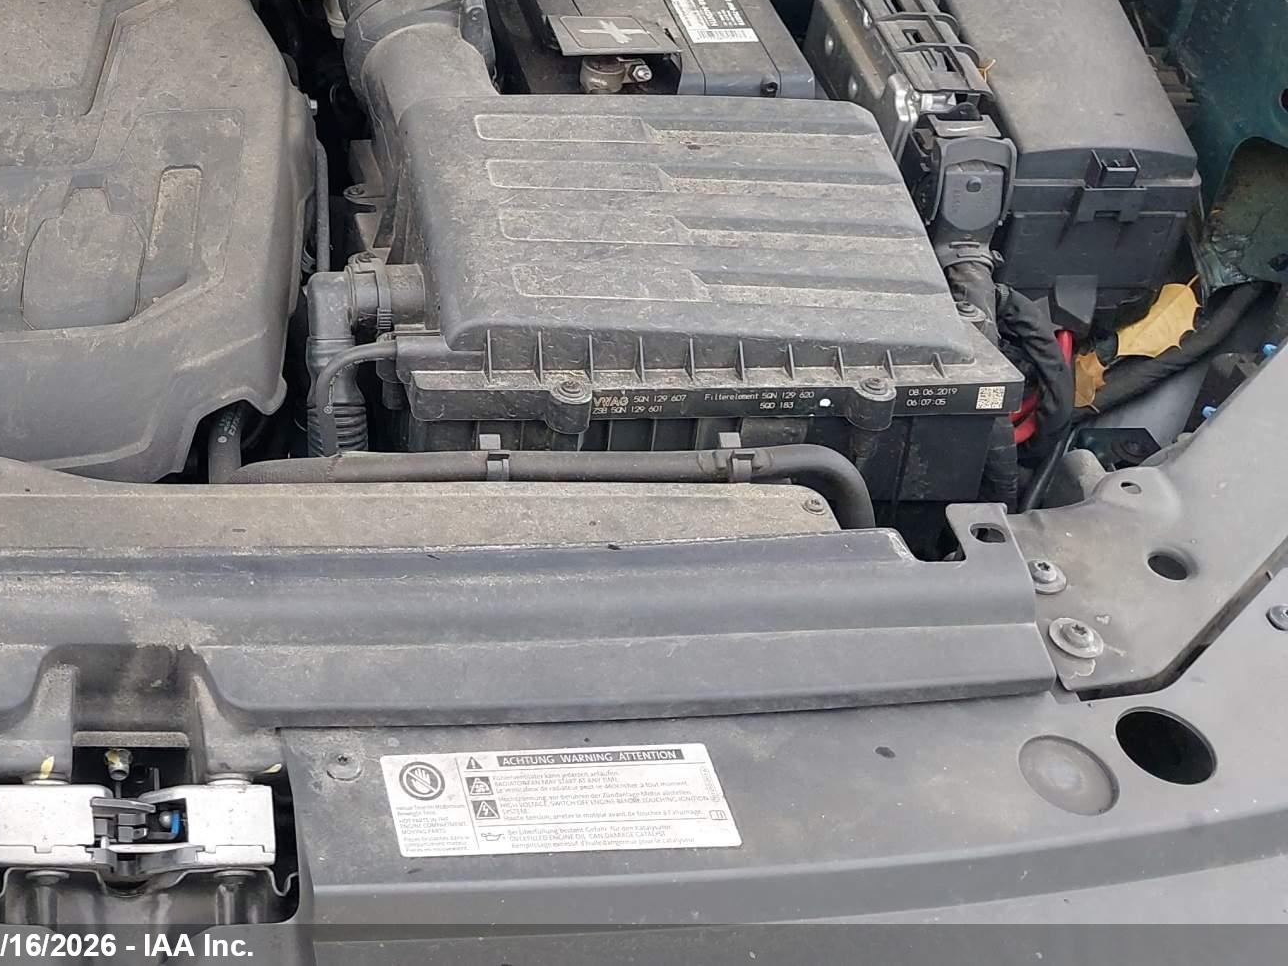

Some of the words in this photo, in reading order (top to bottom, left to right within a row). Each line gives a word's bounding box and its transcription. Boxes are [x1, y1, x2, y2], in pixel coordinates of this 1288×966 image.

[503, 756, 556, 766] ACHTUNG
[560, 753, 613, 763] WARNING
[619, 750, 676, 760] ATTENTION
